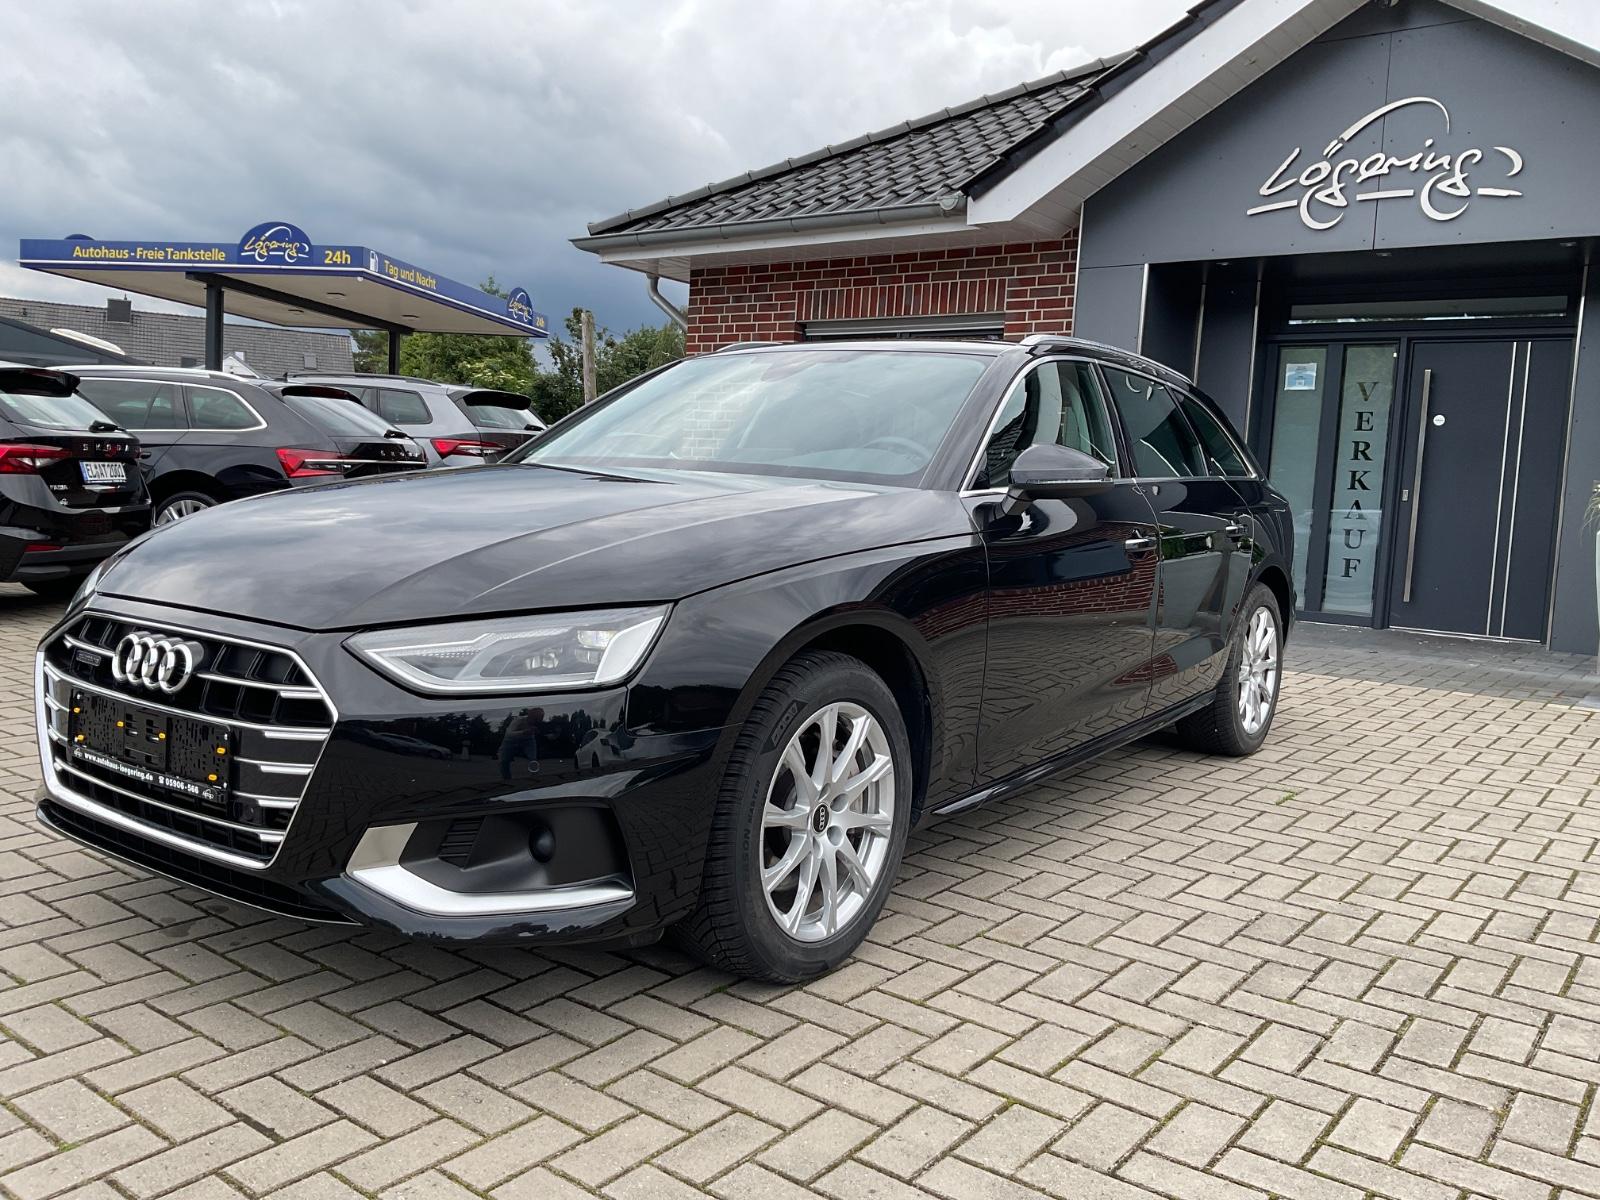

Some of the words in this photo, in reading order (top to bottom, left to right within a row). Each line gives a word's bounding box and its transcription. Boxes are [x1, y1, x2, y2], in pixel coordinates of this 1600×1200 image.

[73, 245, 129, 260] Autohaus
[136, 247, 165, 260] Freie
[166, 247, 226, 261] Tankstelle
[324, 250, 351, 265] 24h
[384, 260, 399, 280] Tag
[400, 268, 415, 282] und
[416, 271, 437, 290] Nacht
[1340, 381, 1380, 578] VERKAUF
[84, 752, 154, 782] www.autohaus-loegering.de
